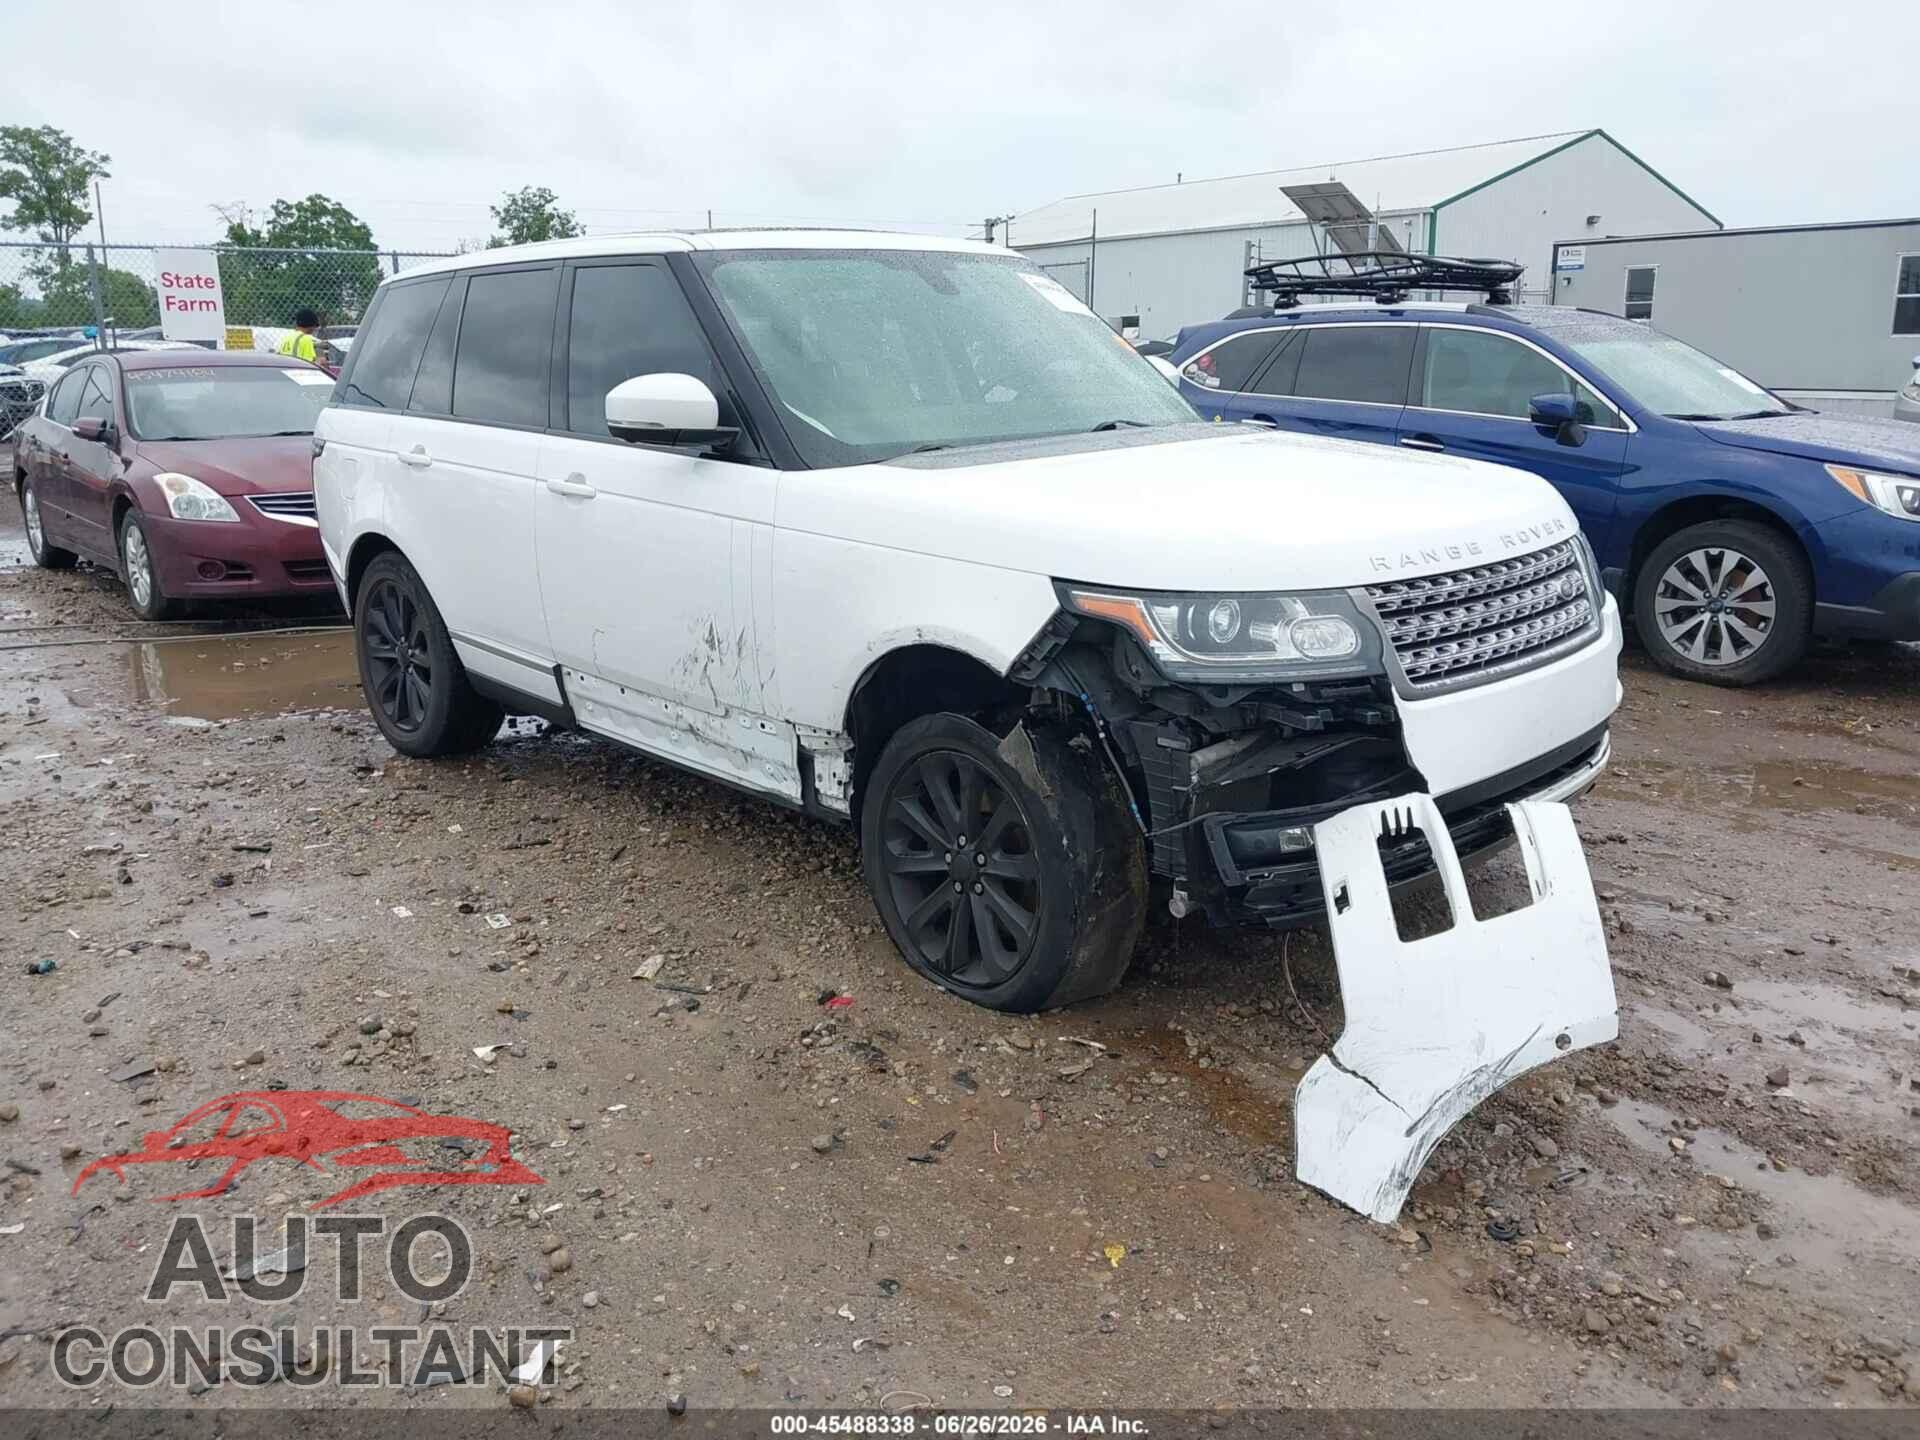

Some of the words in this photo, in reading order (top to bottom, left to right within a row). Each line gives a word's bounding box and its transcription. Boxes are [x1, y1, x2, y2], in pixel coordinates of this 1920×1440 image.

[161, 271, 216, 289] State
[165, 295, 217, 312] Farm
[1369, 541, 1483, 572] RANGE
[1499, 518, 1567, 549] ROVER
